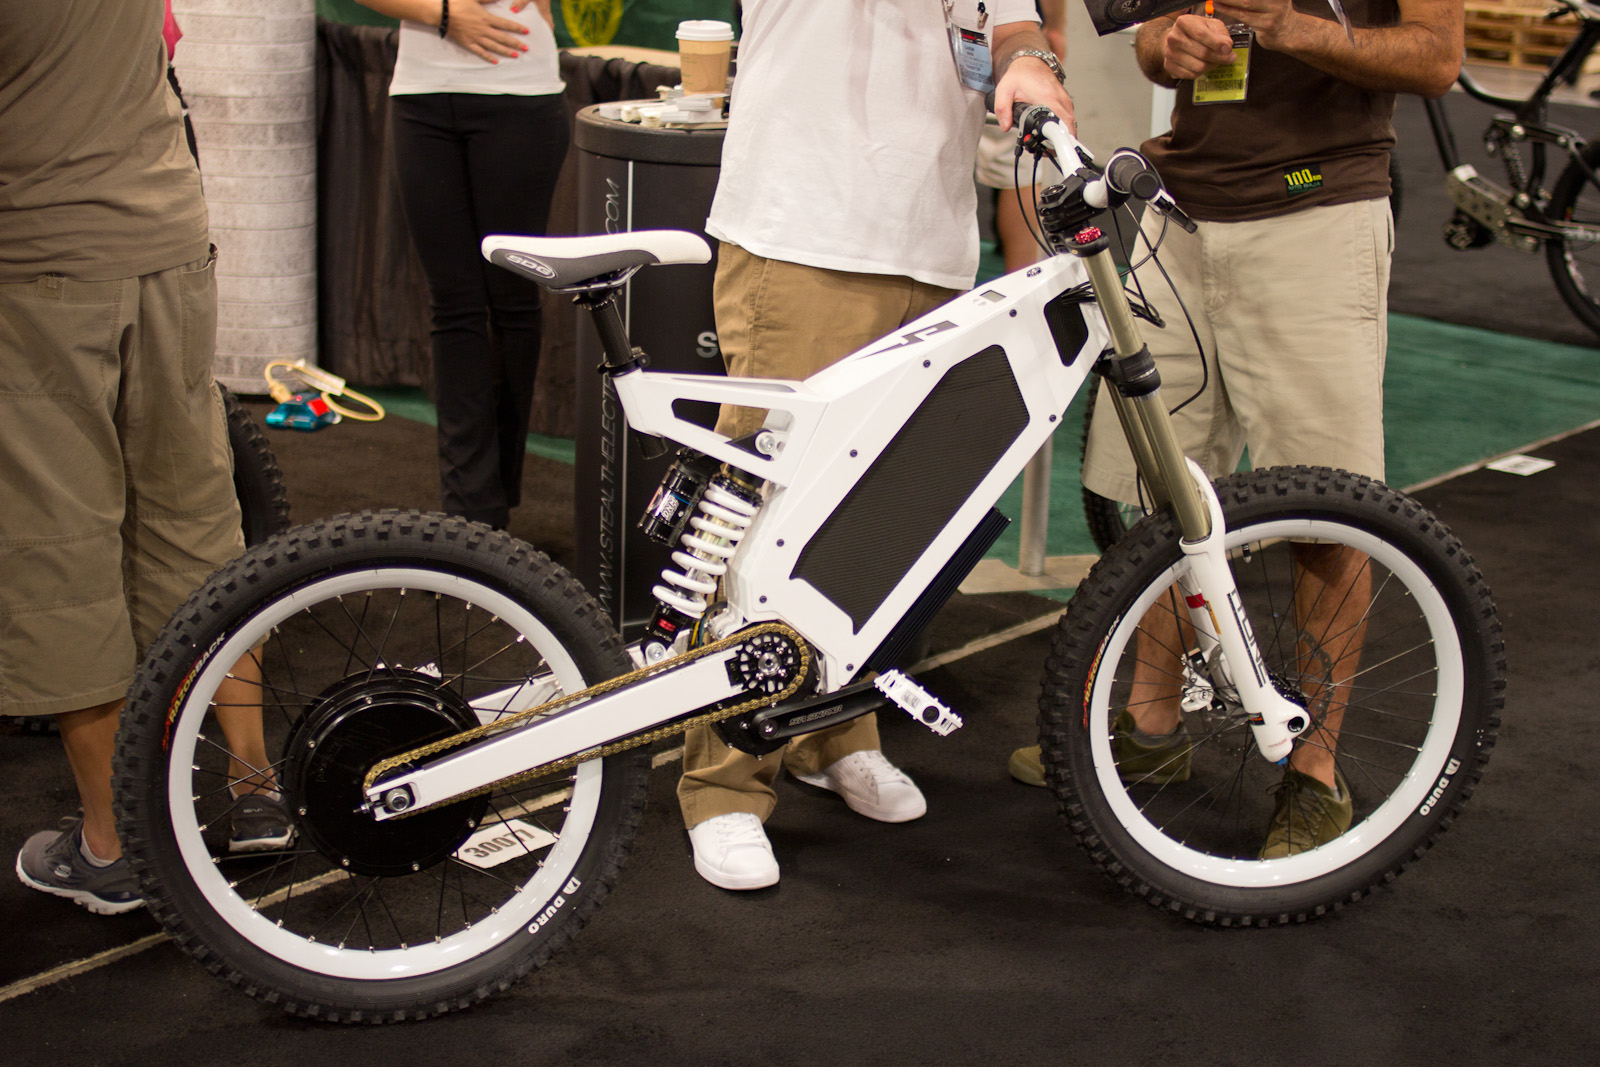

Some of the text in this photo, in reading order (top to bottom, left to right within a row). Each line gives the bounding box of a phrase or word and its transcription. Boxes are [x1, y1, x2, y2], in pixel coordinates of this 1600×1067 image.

[507, 254, 553, 276] SDG
[697, 331, 719, 359] S
[599, 177, 620, 613] WWW.STEALTHELECTR COM
[169, 631, 226, 723] RAZORBACK
[1084, 614, 1121, 703] RAZORBACK
[1419, 776, 1450, 816] DURO
[464, 828, 536, 859] 30077
[528, 895, 566, 935] DURO
